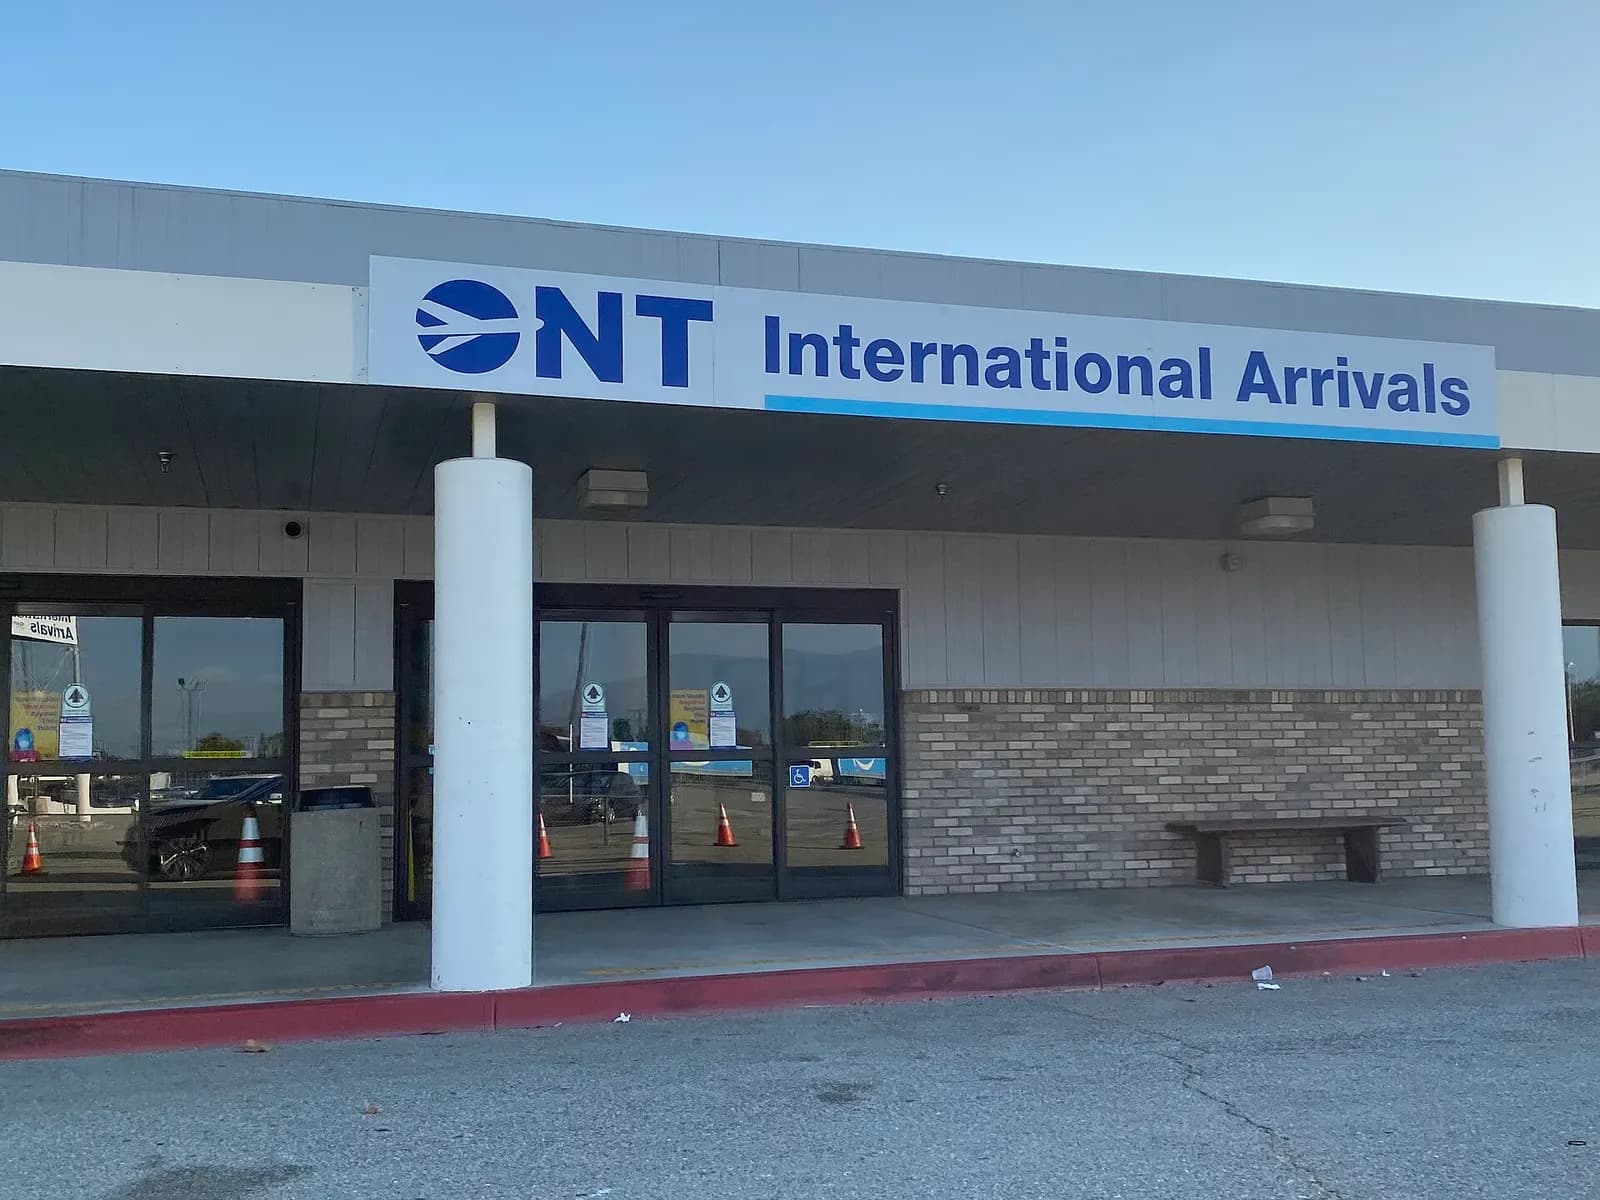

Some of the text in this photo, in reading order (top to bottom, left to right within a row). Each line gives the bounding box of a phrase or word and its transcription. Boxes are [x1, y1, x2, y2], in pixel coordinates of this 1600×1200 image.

[415, 279, 1471, 416] ONT International Arrivals
